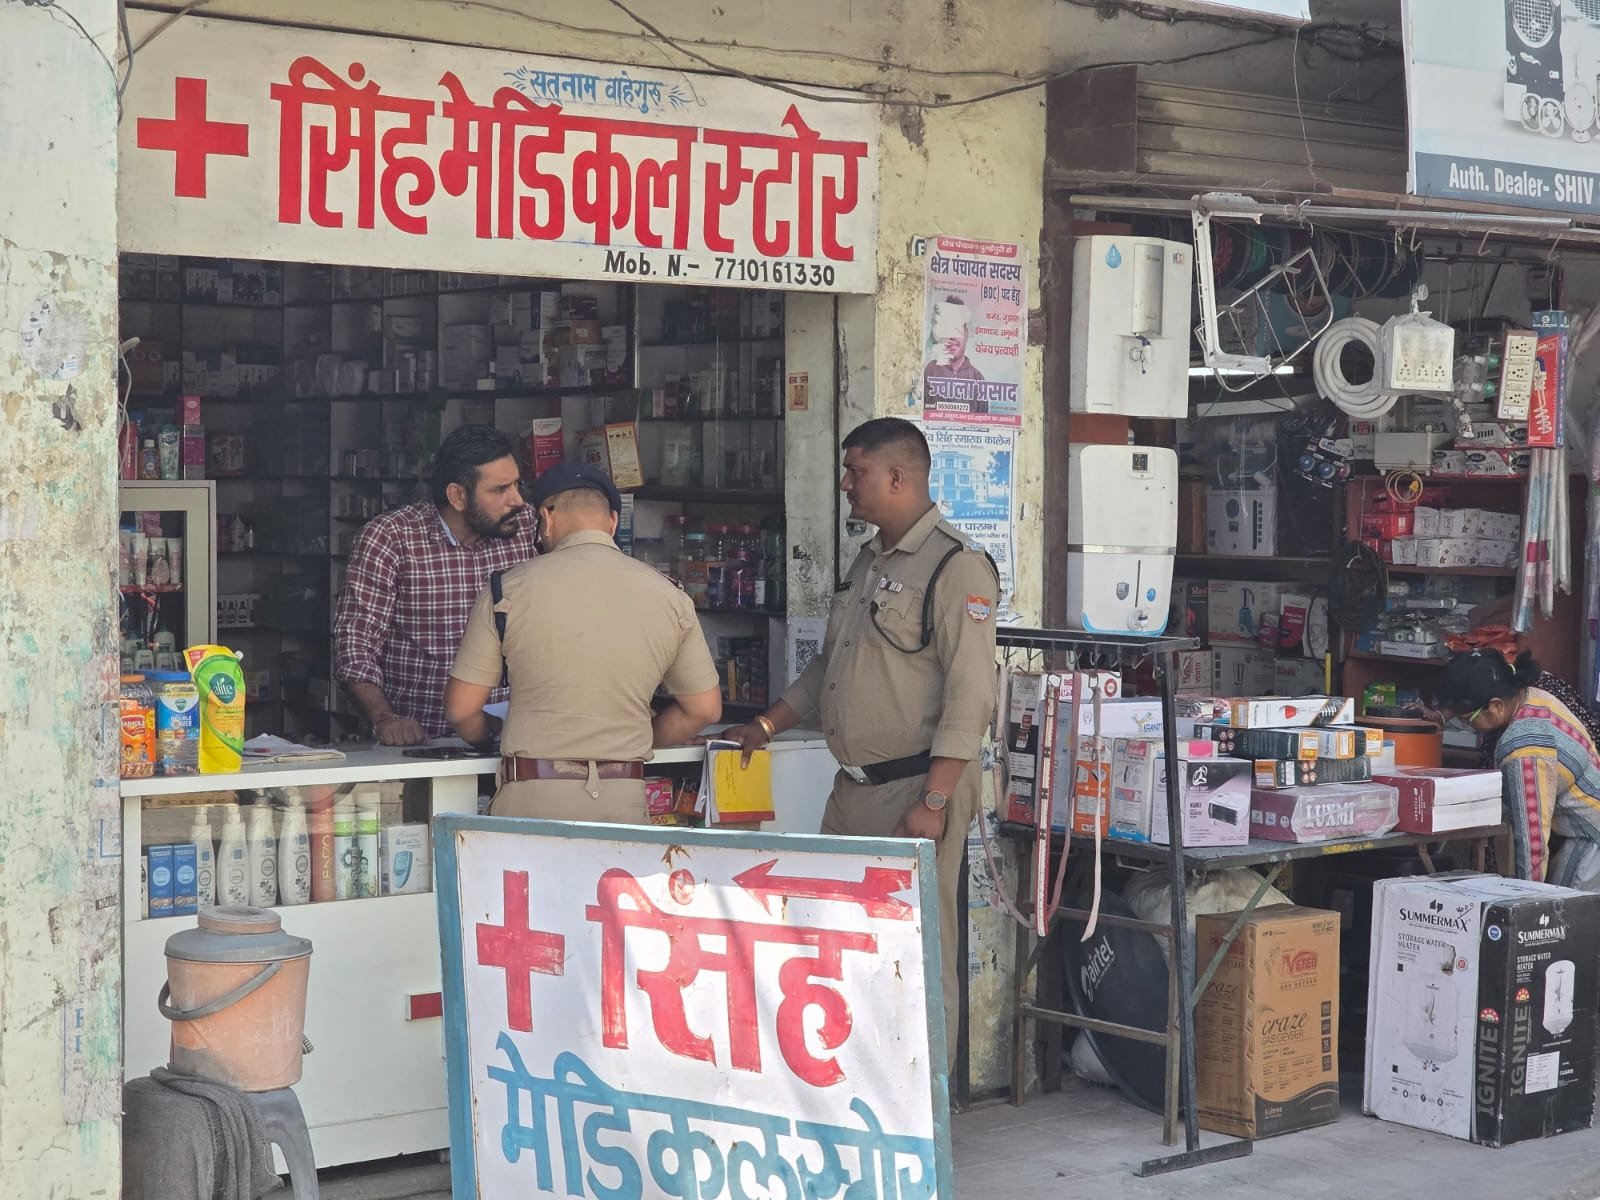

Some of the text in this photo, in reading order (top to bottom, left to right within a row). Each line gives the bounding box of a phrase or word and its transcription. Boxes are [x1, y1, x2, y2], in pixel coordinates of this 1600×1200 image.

[530, 70, 601, 103] सतनाम
[270, 56, 868, 262] सिंह मेडिकल स्टोर
[1449, 162, 1489, 191] Auth.
[1554, 173, 1594, 205] SHIV
[602, 250, 657, 276] Mob.
[714, 257, 835, 286] 7710161330
[930, 251, 1022, 281] क्षेत्र पंचायत सदस्य
[980, 283, 1000, 303] (BDC)
[1001, 288, 1010, 300] पद
[927, 376, 1018, 403] ज्वाला प्रसाद
[1304, 801, 1355, 829] LUXMI
[1399, 907, 1468, 933] SUMMERMAX
[1517, 925, 1566, 944] SUMMERMAX
[1087, 935, 1114, 983] airtel
[585, 867, 878, 1088] सिंह
[1261, 1012, 1308, 1036] craze
[1509, 1006, 1528, 1097] IGNITE
[1477, 1024, 1499, 1117] IGNITE
[487, 1031, 791, 1200] मेडिकल
